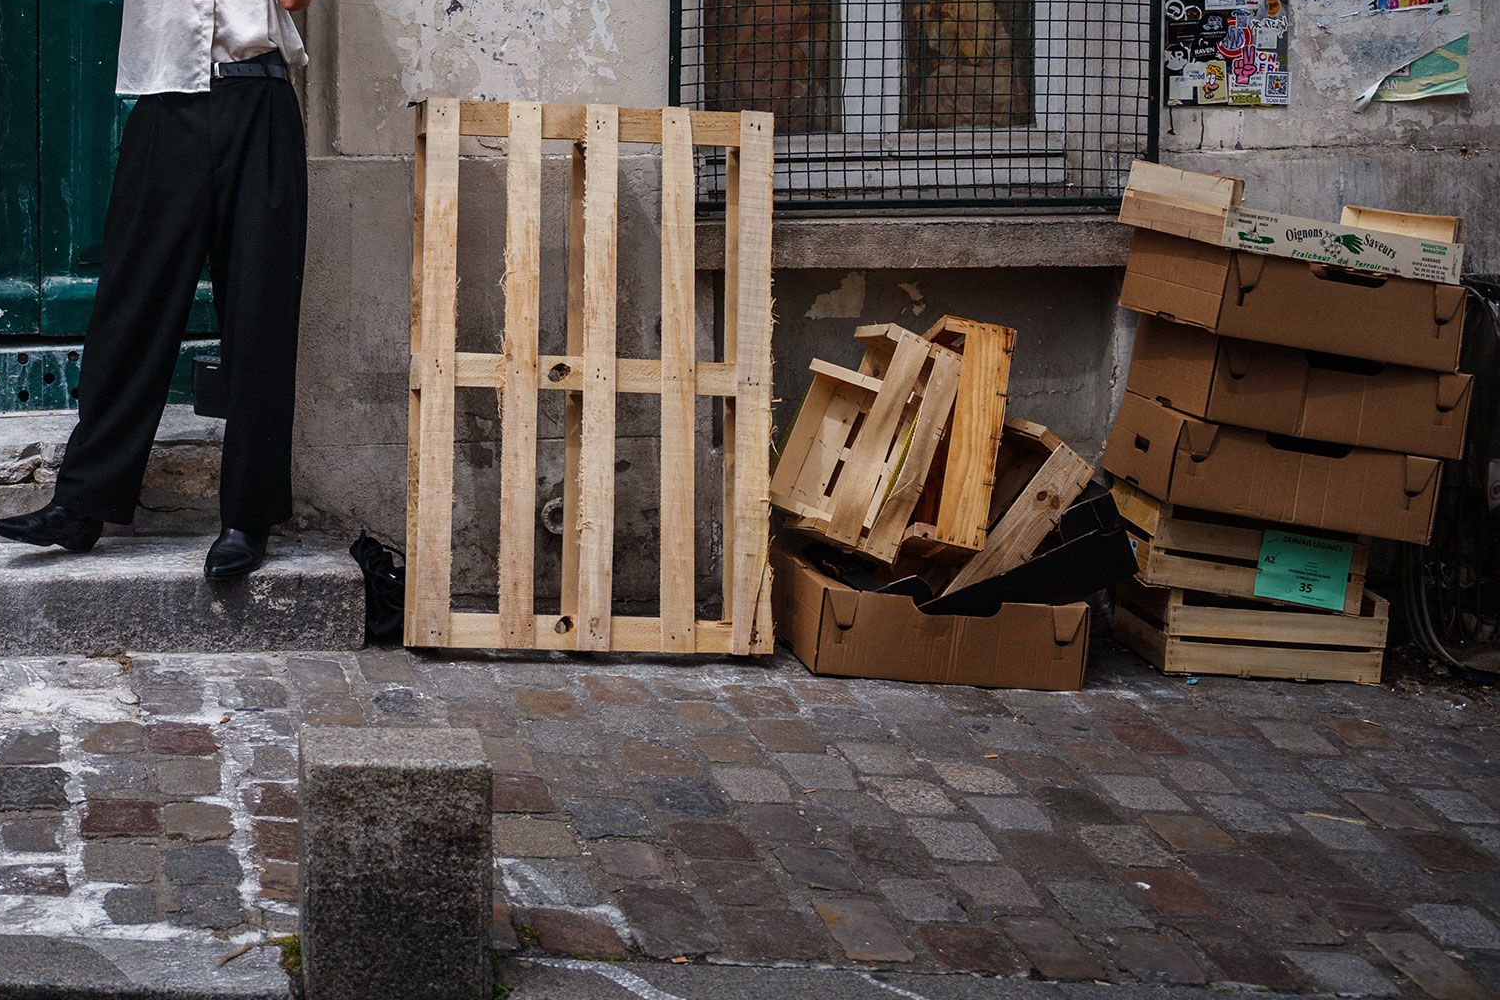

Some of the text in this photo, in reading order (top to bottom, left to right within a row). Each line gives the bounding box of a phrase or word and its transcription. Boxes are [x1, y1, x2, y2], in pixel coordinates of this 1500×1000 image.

[1194, 47, 1215, 55] RAVEN
[1285, 227, 1397, 260] Oignons Saveurs
[1337, 256, 1348, 265] du
[1354, 259, 1381, 271] Terroir
[1282, 535, 1313, 548] GERVAIS
[1264, 555, 1276, 564] A2
[1298, 582, 1313, 593] 35
